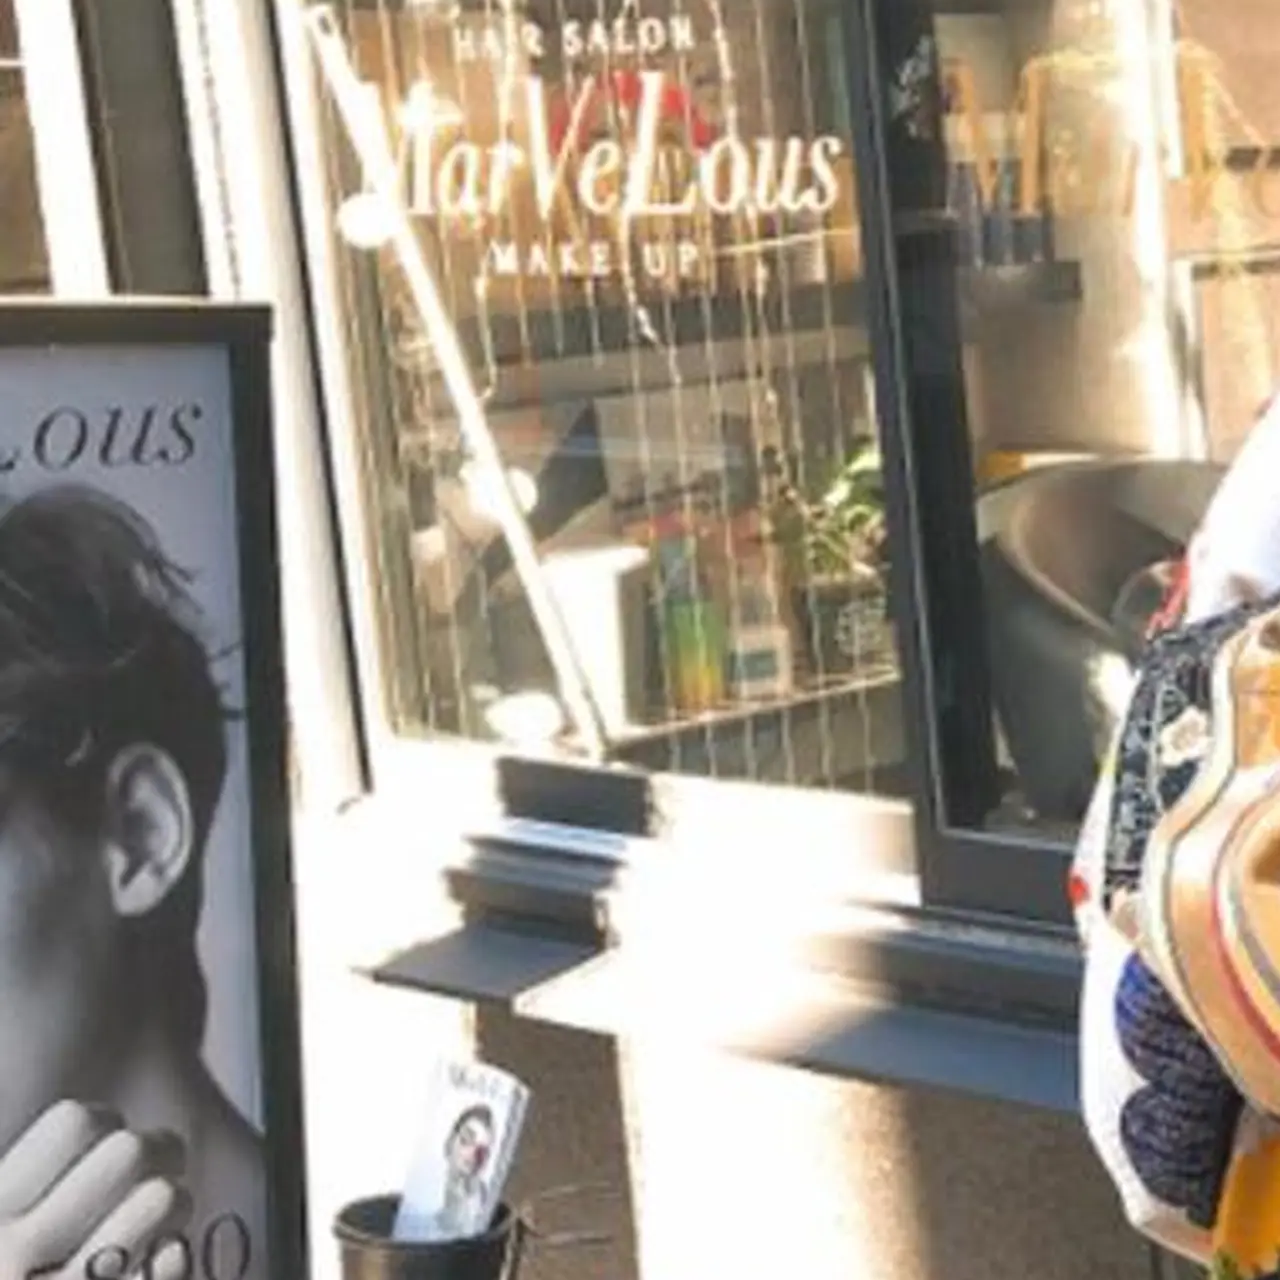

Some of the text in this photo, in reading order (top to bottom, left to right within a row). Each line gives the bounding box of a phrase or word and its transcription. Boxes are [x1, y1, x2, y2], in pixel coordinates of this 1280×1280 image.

[560, 17, 694, 57] SALON
[486, 239, 699, 278] MAKE UP
